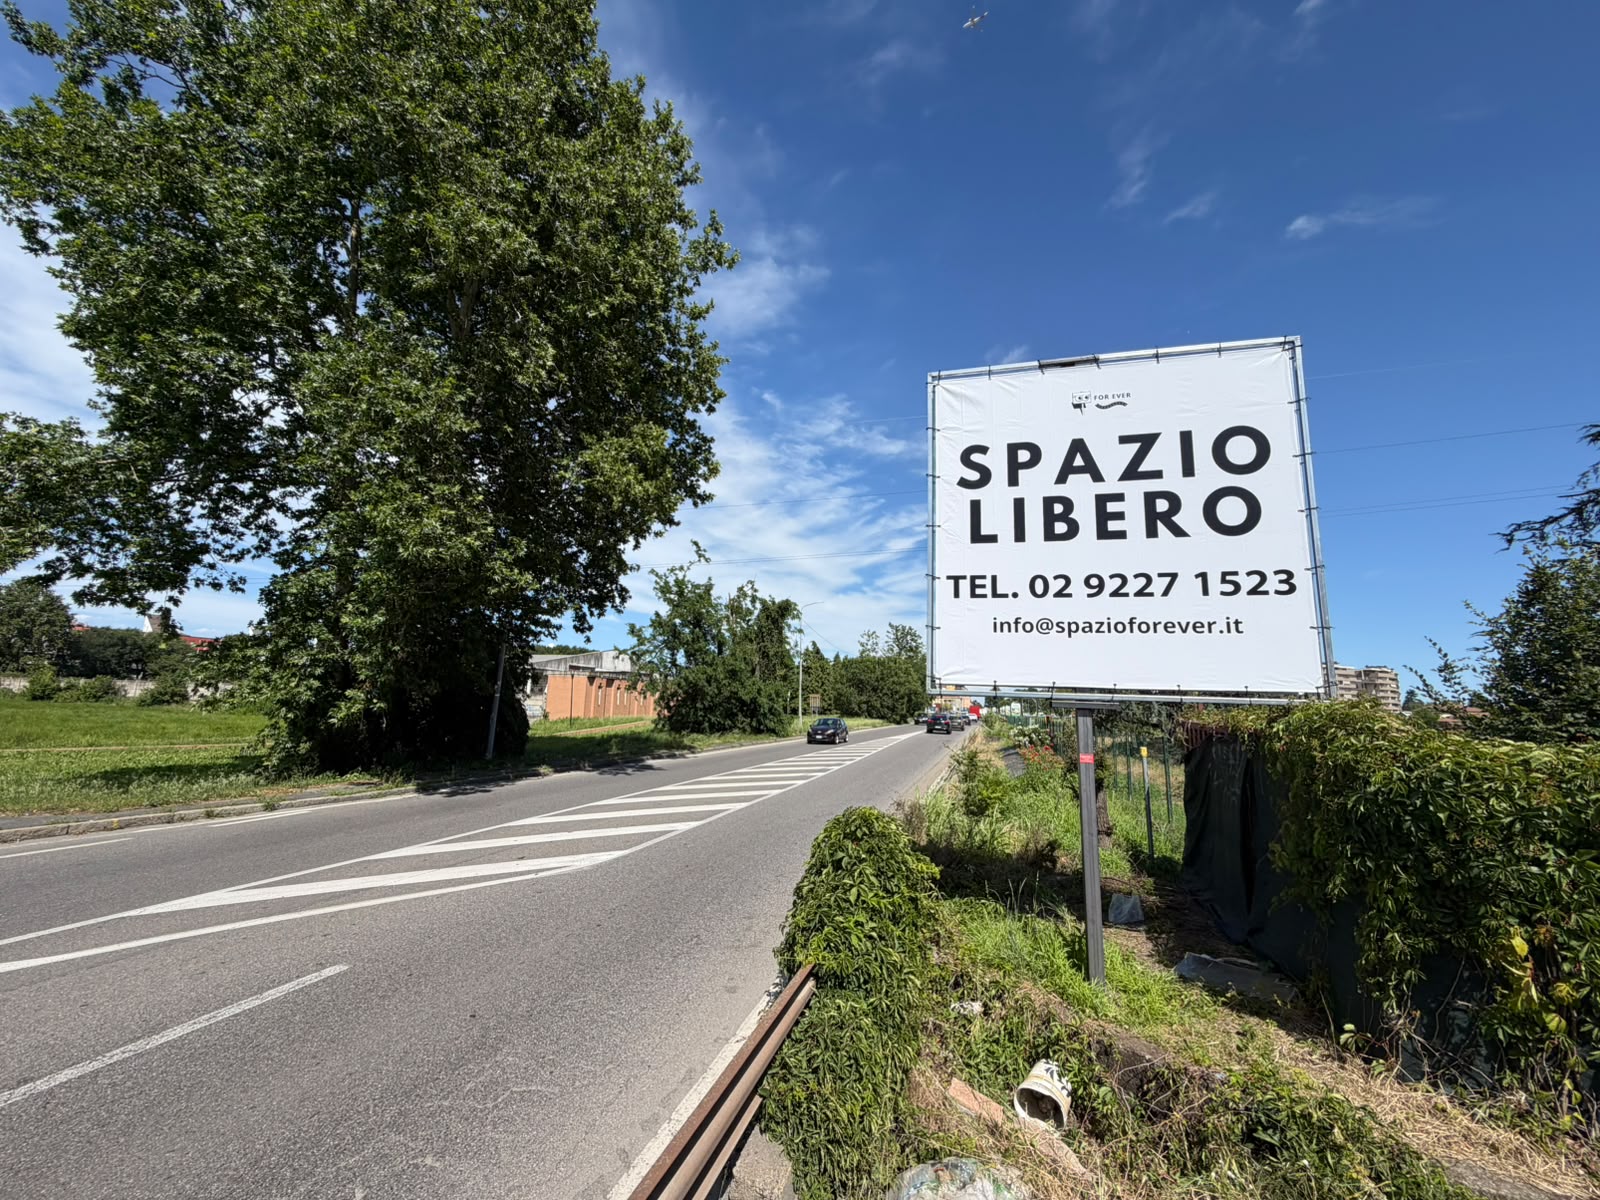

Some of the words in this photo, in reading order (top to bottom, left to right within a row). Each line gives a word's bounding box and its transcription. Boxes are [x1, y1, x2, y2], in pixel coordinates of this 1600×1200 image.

[1112, 392, 1131, 400] EVER
[956, 425, 1271, 490] SPAZIO
[969, 485, 1262, 545] LIBERO
[946, 574, 1019, 599] TEL.
[1028, 573, 1073, 599] 02
[1083, 572, 1179, 599] 9227
[1194, 569, 1297, 597] 1523
[993, 616, 1244, 638] info@spazioforever.it
